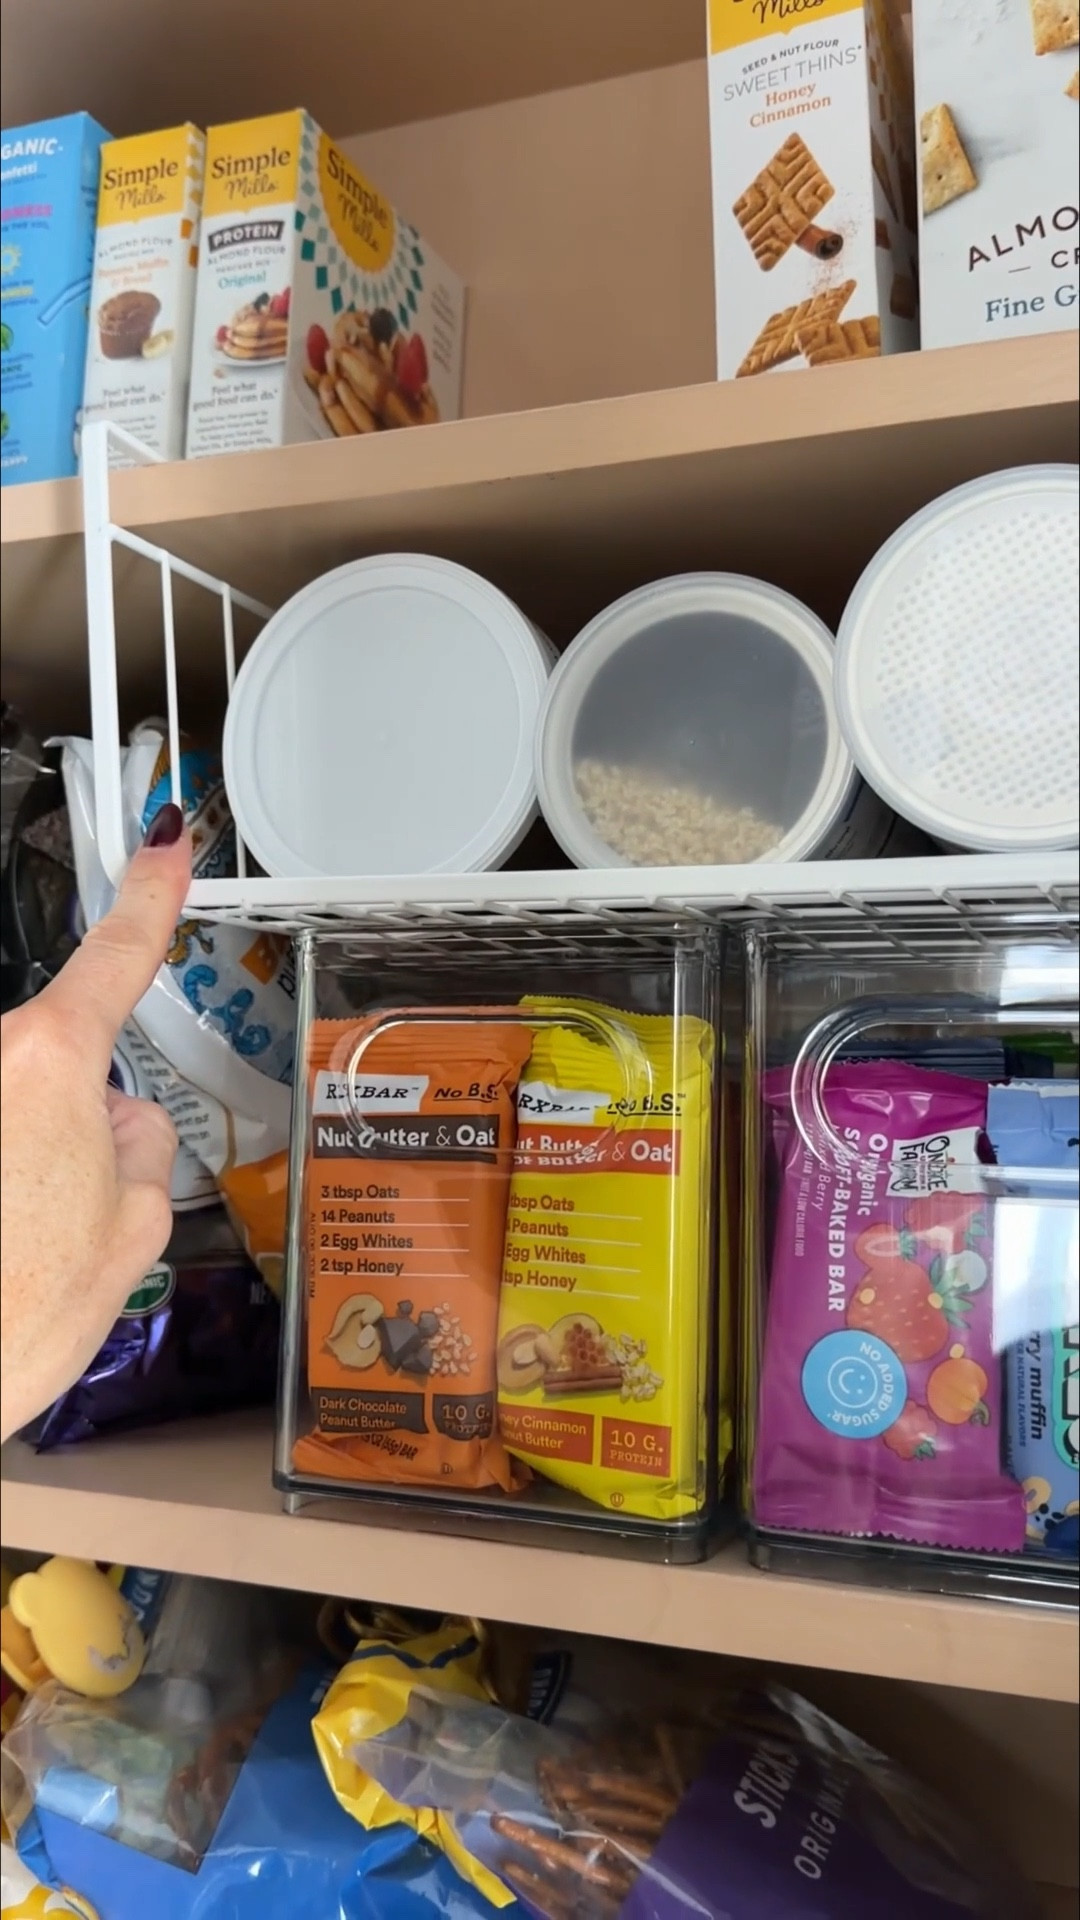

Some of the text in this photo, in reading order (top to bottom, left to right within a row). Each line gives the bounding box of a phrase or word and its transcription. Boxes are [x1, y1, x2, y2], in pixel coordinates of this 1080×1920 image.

[742, 39, 839, 75] SEED & NUT FLOUR
[723, 66, 790, 102] SWEET
[765, 83, 817, 107] Honey
[749, 96, 832, 128] Cinnamon
[103, 158, 179, 190] Simple
[211, 147, 291, 180] Simple
[116, 184, 166, 210] Mills
[225, 174, 278, 200] Mills
[326, 147, 389, 230] Simple
[338, 193, 380, 252] Mills
[212, 223, 280, 247] PROTEIN
[967, 205, 1079, 272] ALMO
[207, 245, 286, 266] ALMOND FLOUR
[218, 270, 267, 290] Original
[985, 296, 1044, 322] Fine
[233, 382, 257, 393] what
[193, 398, 216, 412] good
[218, 395, 238, 406] food
[434, 1087, 463, 1098] No
[318, 1127, 353, 1148] Nut
[436, 1126, 451, 1146] &
[456, 1125, 495, 1146] Oat
[612, 1141, 626, 1161] &
[631, 1139, 672, 1162] Oat
[891, 1142, 926, 1191] FAM
[321, 1184, 400, 1201] 3 tbsp Oats
[540, 1195, 575, 1212] Oats
[811, 1174, 831, 1211] Berry
[321, 1210, 395, 1223] 14 Peanuts
[512, 1217, 569, 1237] Peanuts
[321, 1233, 413, 1250] 2 Egg Whites
[505, 1243, 586, 1265] Egg Whites
[320, 1259, 329, 1271] 2
[332, 1259, 353, 1275] tsp
[356, 1258, 404, 1276] Honey
[527, 1269, 577, 1293] Honey
[828, 1268, 846, 1312] BAR
[860, 1342, 881, 1361] NO
[877, 1363, 894, 1412] ADDED
[1016, 1356, 1026, 1400] NATURAL
[320, 1396, 407, 1415] Dark Chocolate
[443, 1404, 468, 1421] 10
[1030, 1366, 1047, 1441] muffin
[320, 1412, 395, 1429] Peanut Butter
[522, 1415, 587, 1436] Cinnamon
[1018, 1403, 1027, 1448] FLAVORS
[525, 1432, 564, 1450] Butter
[610, 1430, 664, 1453] 10 G.
[610, 1450, 662, 1467] PROTEIN
